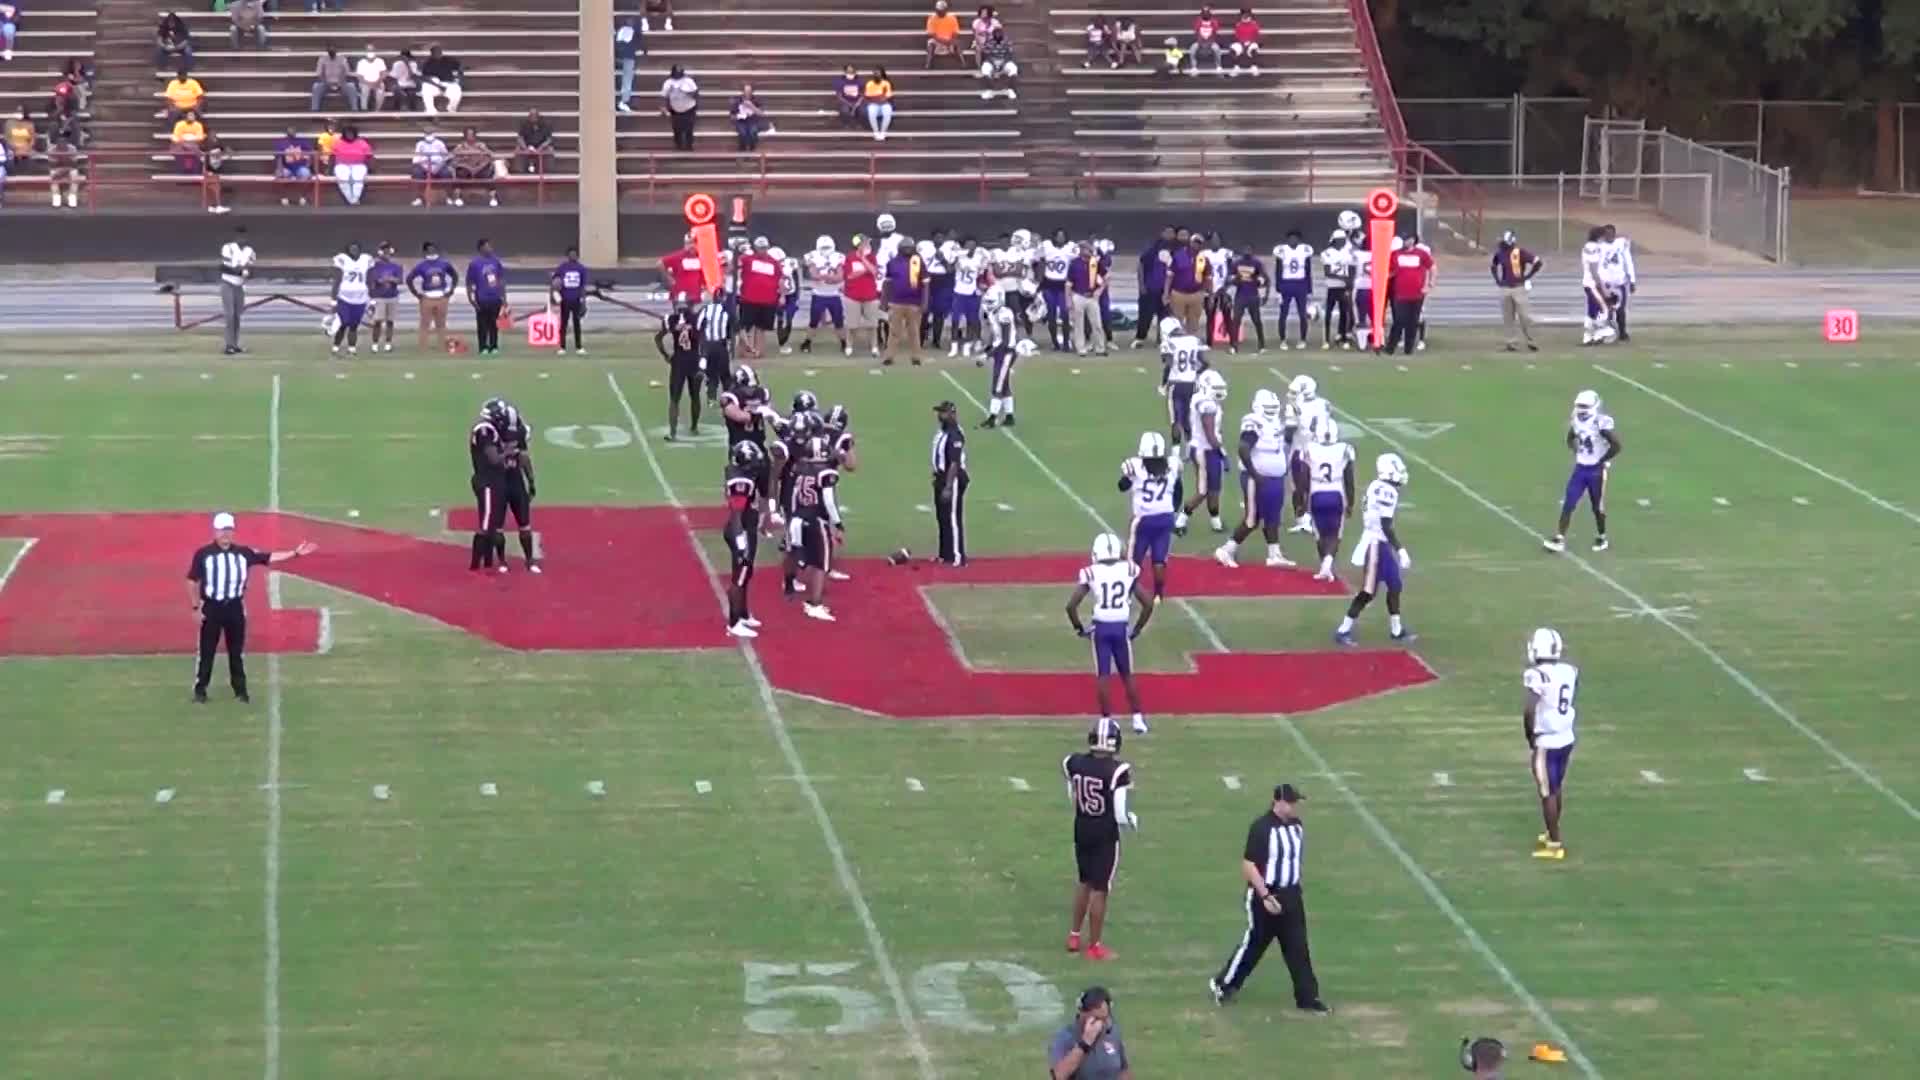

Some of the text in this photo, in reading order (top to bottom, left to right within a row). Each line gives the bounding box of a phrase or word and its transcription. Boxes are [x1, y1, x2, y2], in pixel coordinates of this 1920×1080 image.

[533, 321, 554, 342] 50
[1831, 316, 1853, 337] 30
[1319, 462, 1333, 483] 3
[1141, 476, 1169, 503] 57
[1100, 580, 1126, 610] 12
[1557, 683, 1570, 715] 6
[1073, 774, 1105, 817] 15
[743, 960, 1065, 1034] 50
